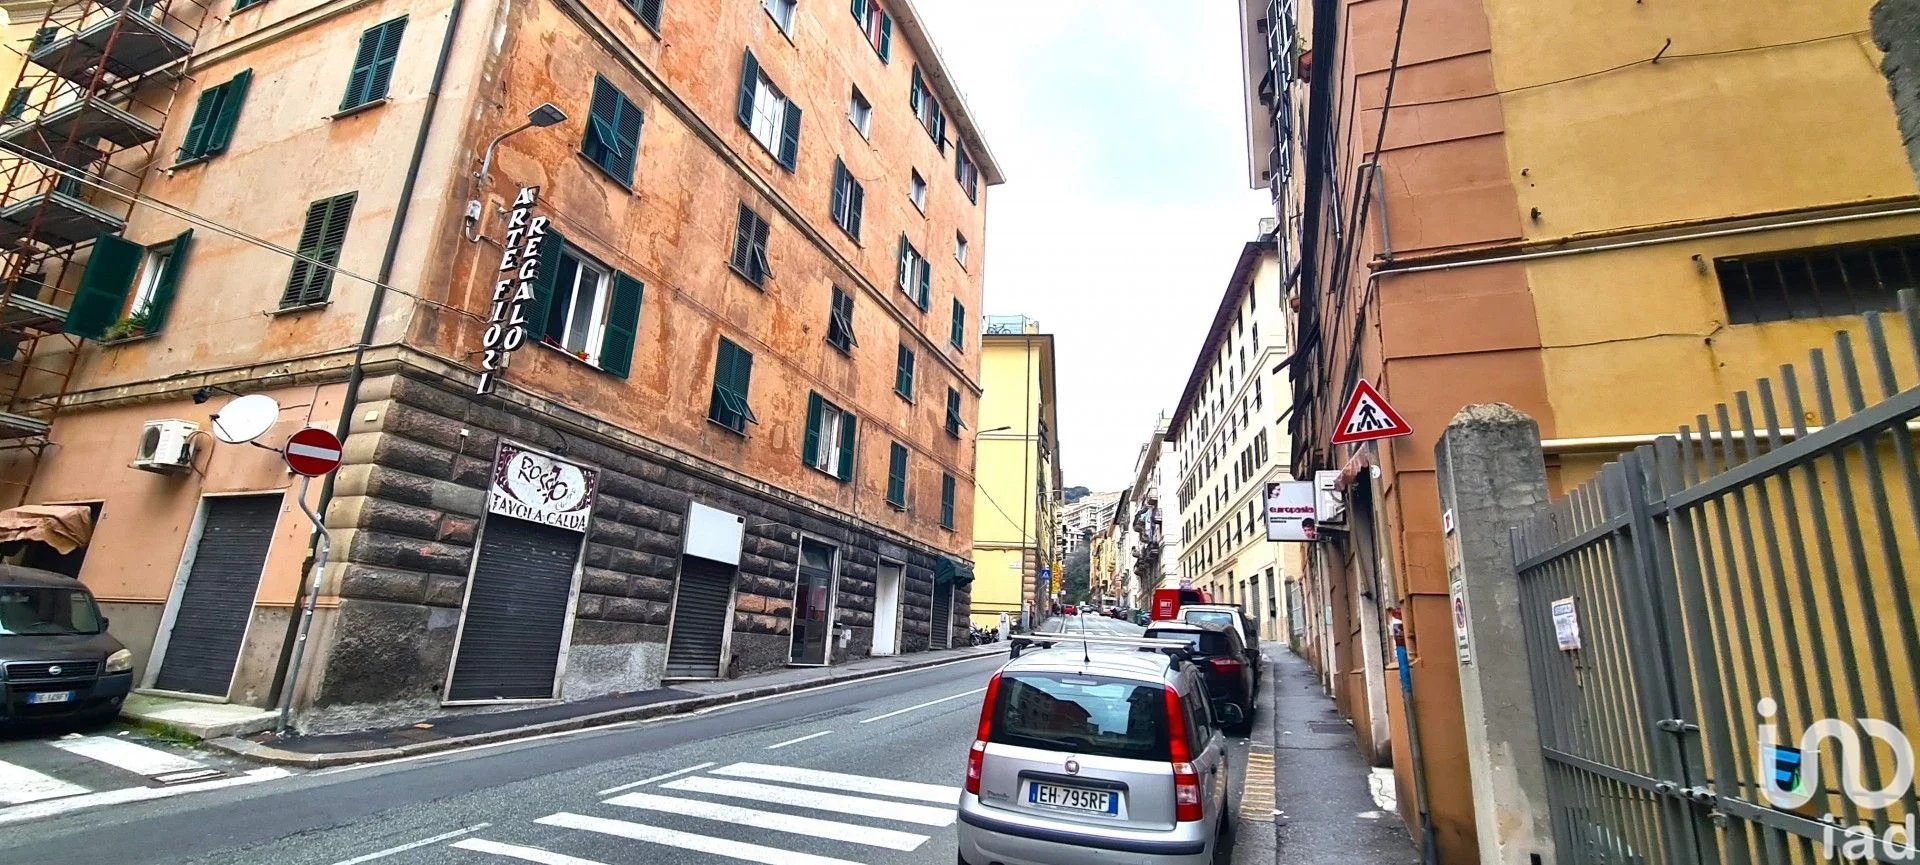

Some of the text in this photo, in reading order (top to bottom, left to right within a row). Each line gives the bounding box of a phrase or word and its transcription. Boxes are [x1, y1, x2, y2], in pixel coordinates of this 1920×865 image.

[500, 187, 531, 271] ARTE
[503, 216, 549, 350] REGALO
[493, 493, 543, 522] TAVOLA
[546, 512, 586, 531] CALDA
